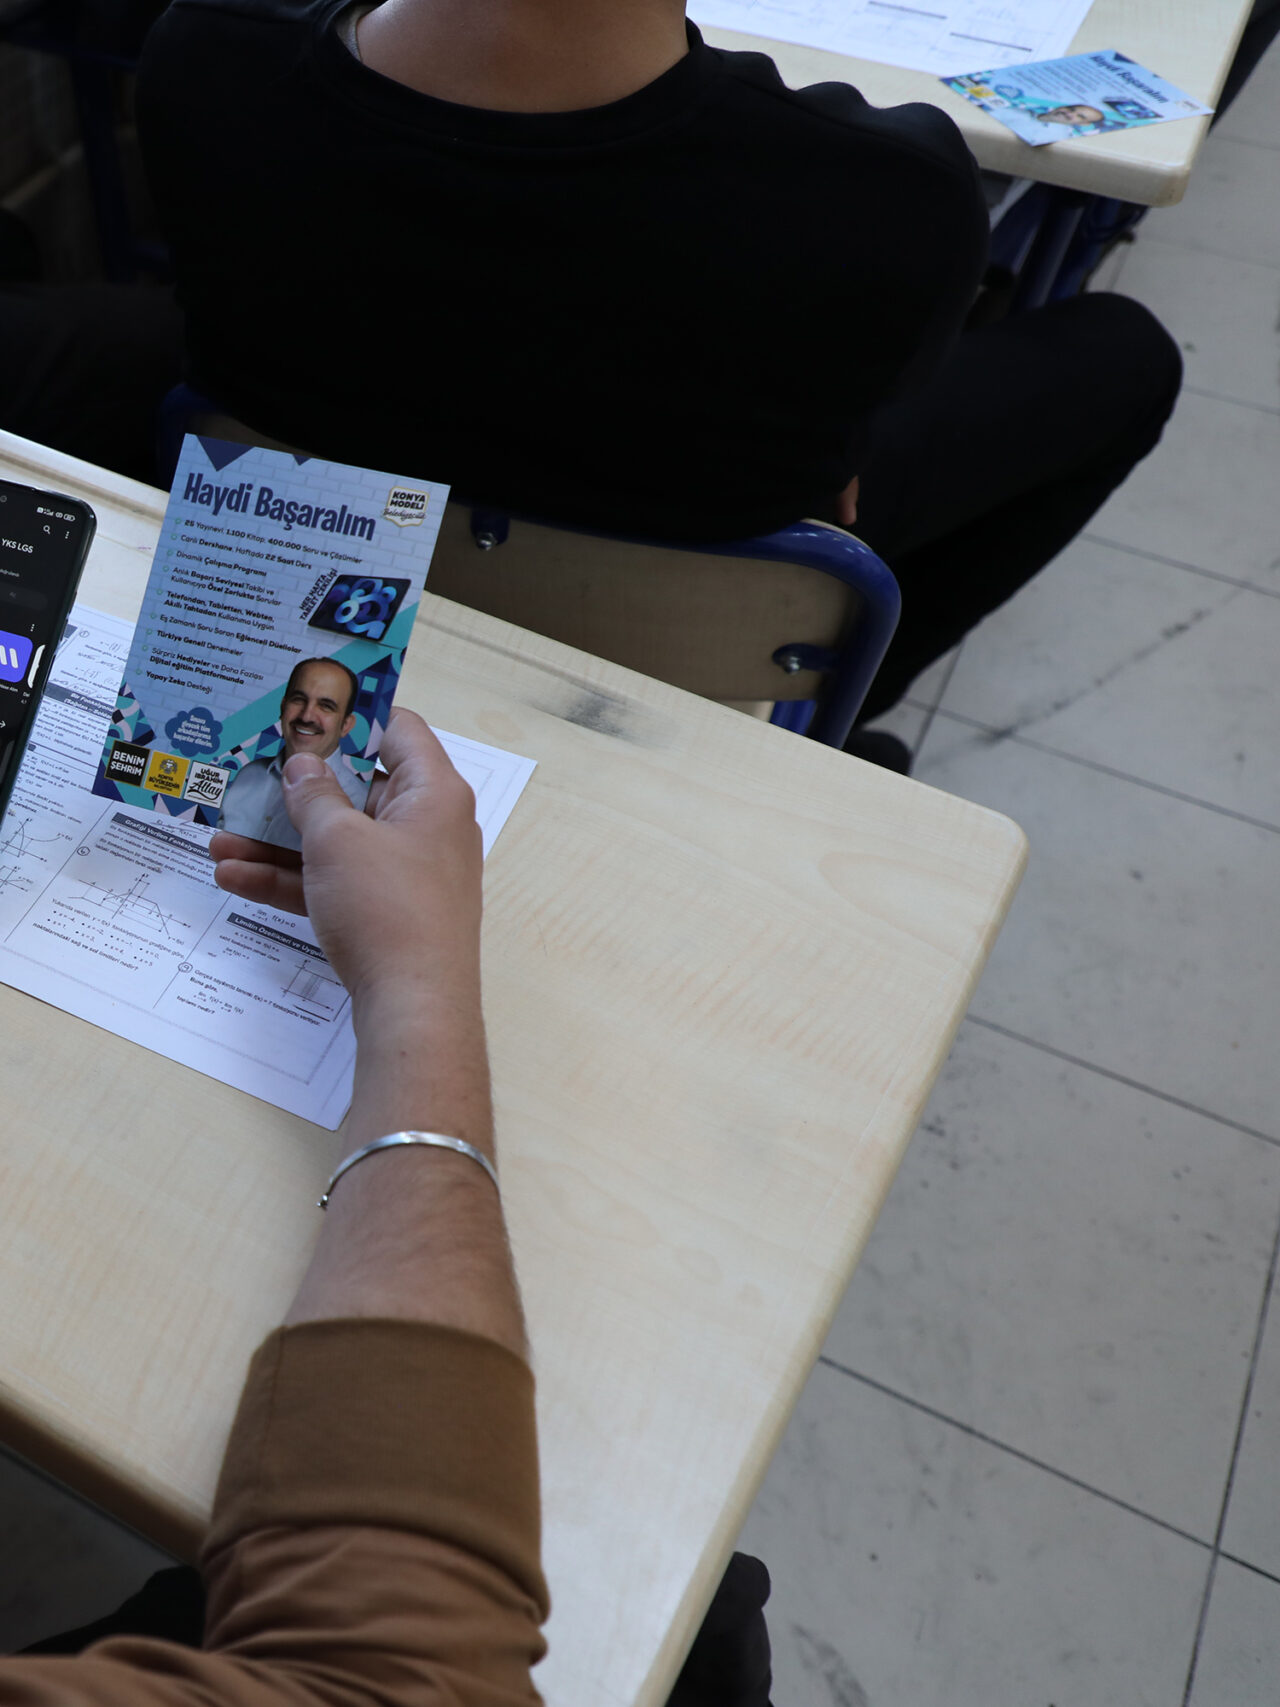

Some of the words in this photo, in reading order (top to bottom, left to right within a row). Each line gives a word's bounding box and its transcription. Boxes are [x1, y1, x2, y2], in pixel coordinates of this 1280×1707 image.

[183, 472, 254, 517] Haydi
[253, 486, 376, 541] Başaralım
[392, 491, 426, 503] KONYA
[0, 538, 17, 549] YKS
[16, 542, 34, 553] LGS
[180, 534, 198, 544] Canlı
[235, 546, 264, 558] Haftada
[265, 553, 276, 561] 22
[276, 556, 294, 565] Saat
[294, 560, 312, 569] Ders
[184, 519, 194, 527] 25
[225, 528, 245, 538] 1.100
[267, 537, 301, 551] 400.000
[302, 545, 319, 555] Soru
[328, 551, 362, 564] Çözümler
[175, 550, 203, 562] Dinamik
[203, 556, 233, 569] Çalışma
[232, 563, 267, 577] Programı
[170, 575, 207, 589] Kullanıcıya
[206, 582, 223, 592] Özel
[223, 587, 255, 600] Zorlukta
[255, 594, 281, 606] Sorular
[172, 566, 189, 576] Anlık
[189, 570, 215, 583] Başarı
[215, 576, 245, 589] Seviyesi
[244, 583, 265, 593] Takibi
[299, 595, 308, 608] HER
[308, 574, 326, 595] HAFTA
[163, 599, 182, 609] Akıllı
[182, 603, 217, 617] Tahtadan
[217, 612, 251, 625] Kullanıma
[251, 620, 274, 632] Uygun
[167, 590, 207, 606] Telefondan,
[208, 600, 244, 615] Tabletten,
[245, 609, 273, 622] Webten,
[299, 596, 318, 620] TABLET
[157, 629, 183, 642] Türkiye
[182, 636, 206, 646] Geneli
[206, 642, 243, 656] Denemeler
[159, 614, 168, 623] Eş
[168, 616, 196, 628] Zamanlı
[196, 623, 213, 633] Soru
[213, 627, 235, 637] Soran
[234, 632, 268, 647] Eğlenceli
[268, 640, 302, 654] Düellolar
[149, 655, 171, 667] Dijital
[171, 661, 194, 673] eğitim
[194, 666, 245, 684] Platformunda
[151, 647, 176, 659] Sürpriz
[176, 653, 210, 667] Hediyeler
[220, 664, 239, 674] Daha
[238, 669, 264, 681] Fazlası
[146, 670, 168, 682] Yapay
[167, 676, 185, 686] Zeka
[186, 680, 213, 694] Desteği
[199, 766, 220, 776] UĞUR
[124, 819, 147, 832] Grafiği
[147, 827, 168, 840] Verilen
[168, 836, 210, 857] Fonksiyonun
[234, 917, 258, 930] Limitin
[258, 926, 292, 944] Özellikleri
